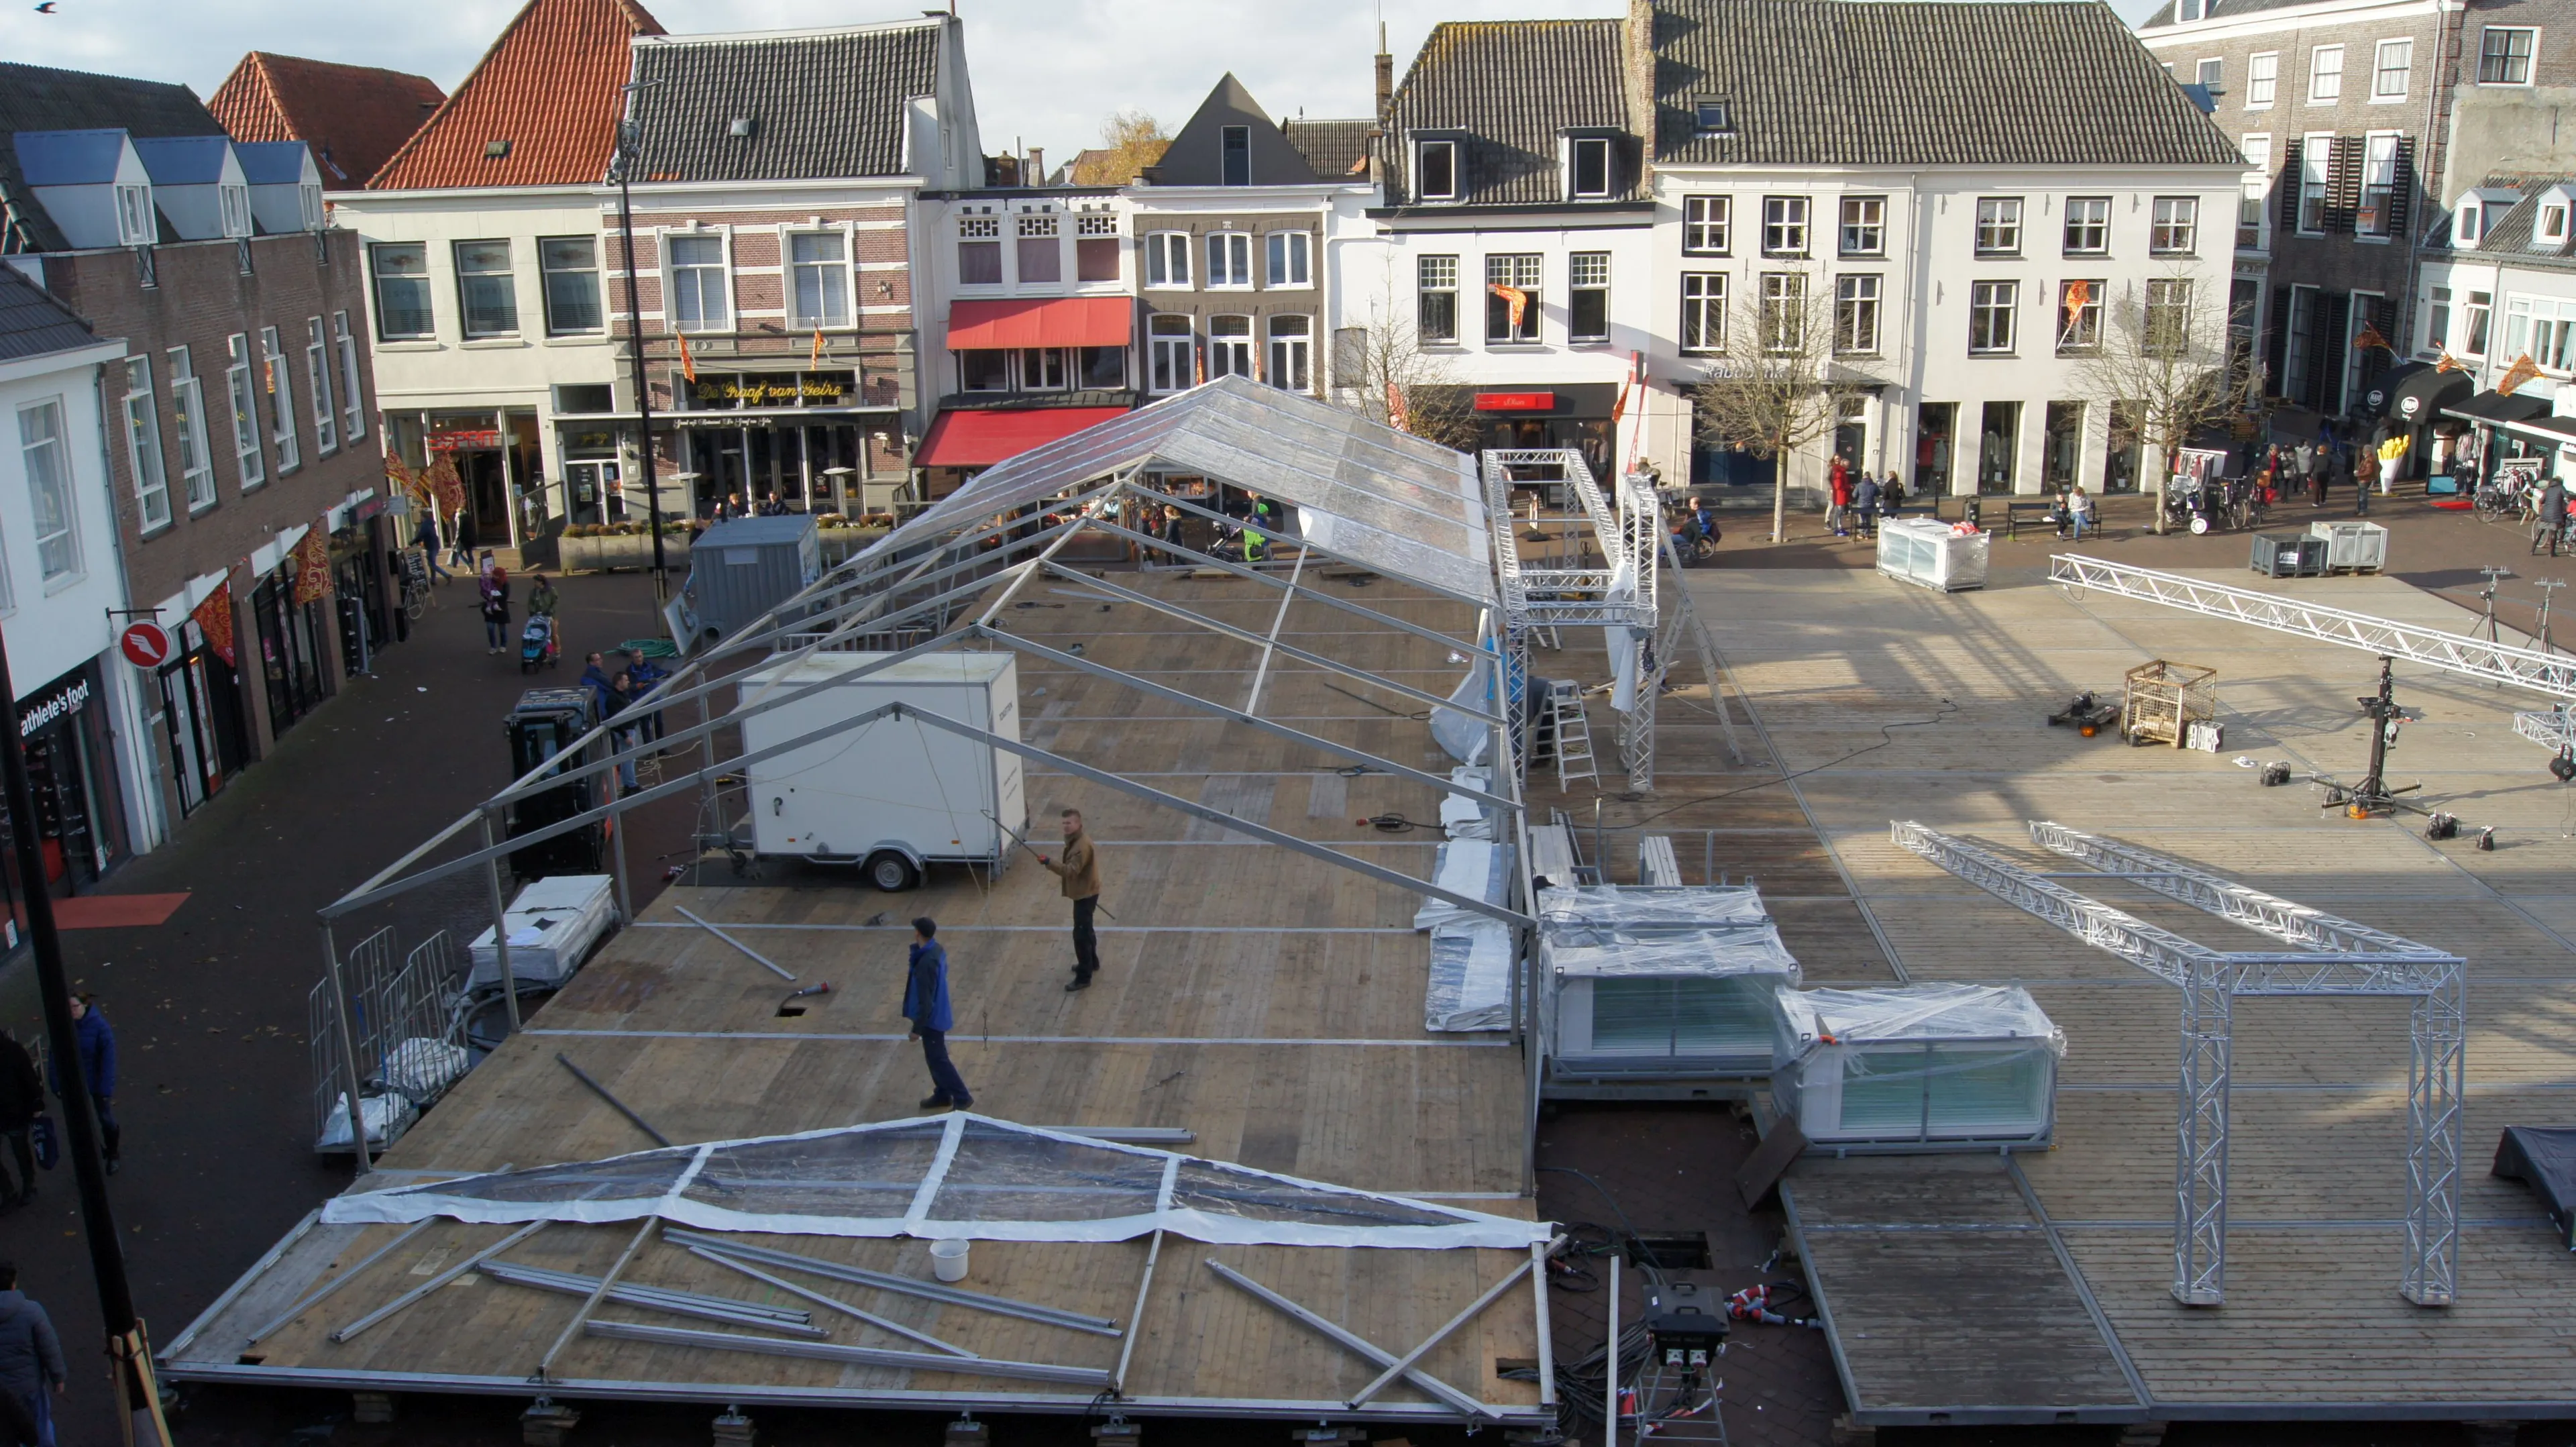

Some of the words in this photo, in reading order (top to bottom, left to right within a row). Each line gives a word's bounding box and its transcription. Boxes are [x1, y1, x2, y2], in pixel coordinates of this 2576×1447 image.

[1703, 364, 1786, 379] Rabobnk
[697, 383, 718, 399] De
[722, 380, 767, 403] Graaf
[768, 386, 798, 398] van
[427, 430, 498, 450] ESPRIT
[21, 694, 68, 737] athlete's
[66, 679, 89, 706] foot
